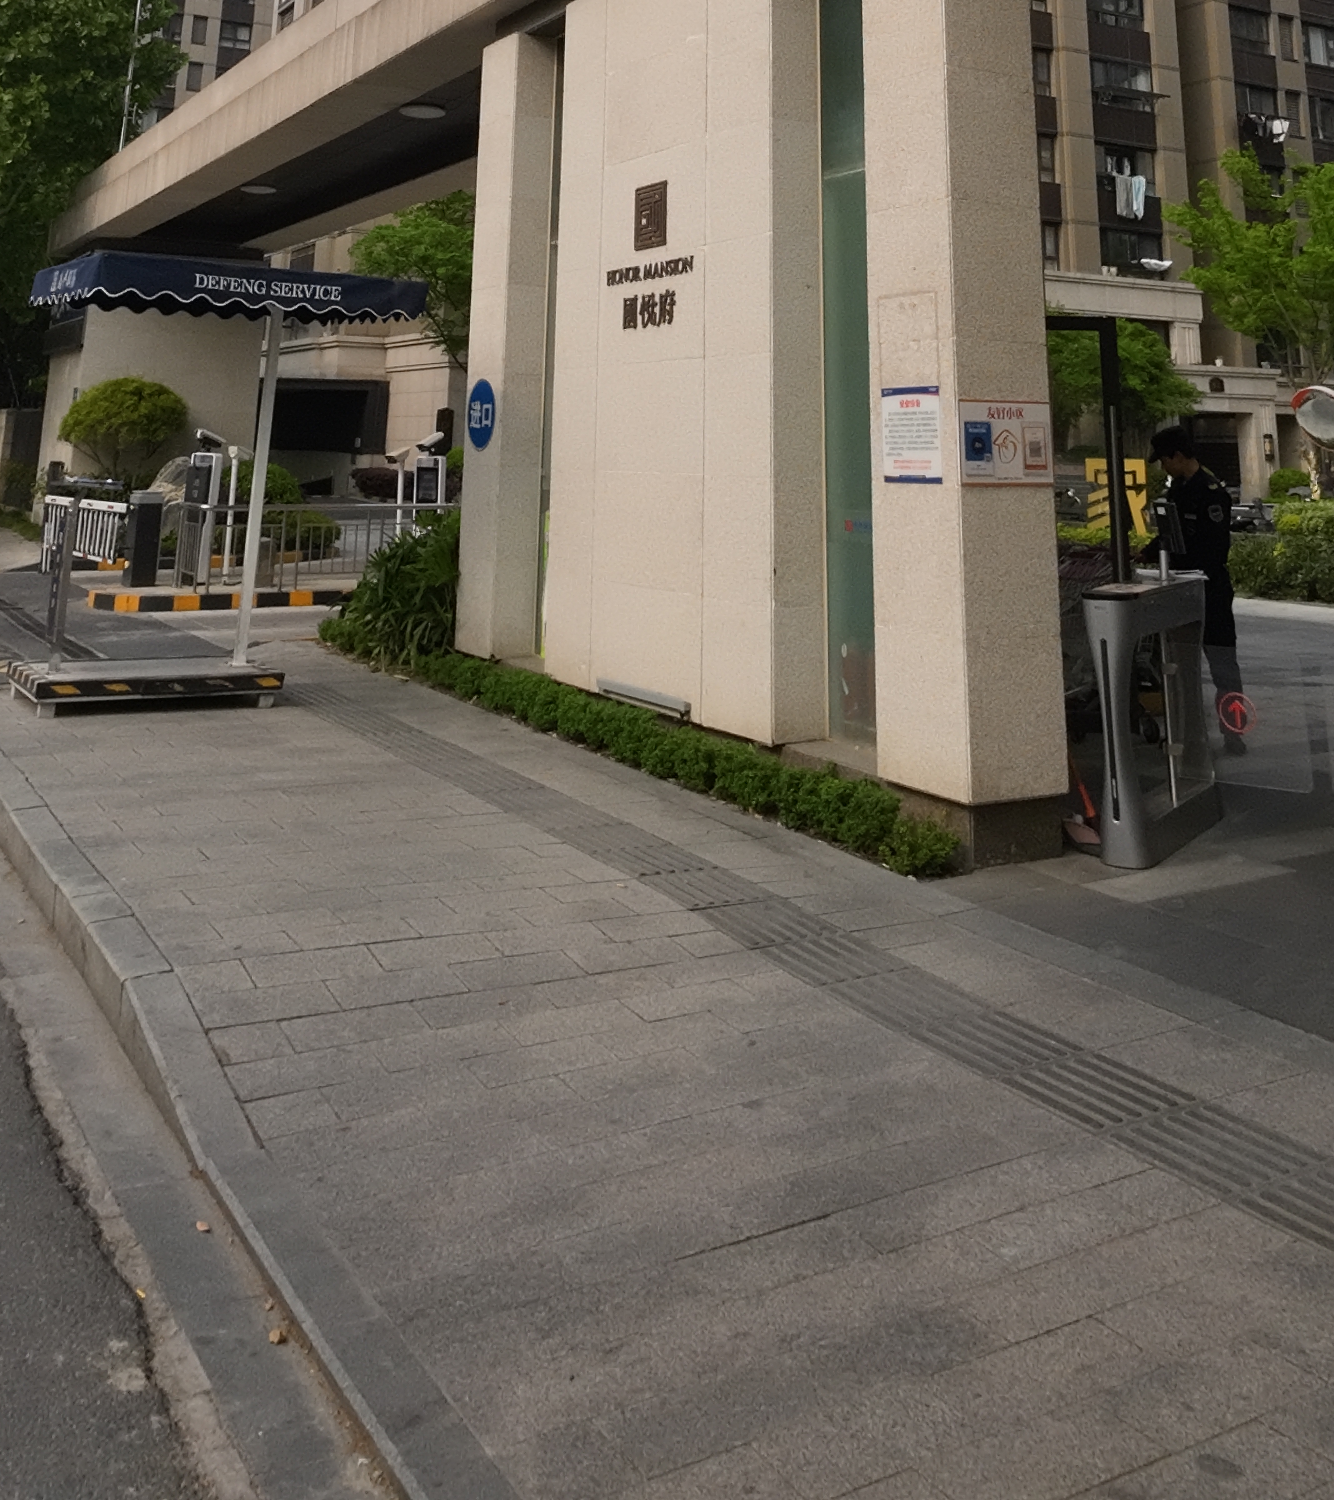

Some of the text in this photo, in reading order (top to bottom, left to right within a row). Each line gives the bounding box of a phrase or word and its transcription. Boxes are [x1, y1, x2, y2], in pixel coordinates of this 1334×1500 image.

[606, 255, 694, 286] HONOR MANSION
[194, 272, 342, 301] DEFENG SERVICE
[470, 401, 492, 429] 进口
